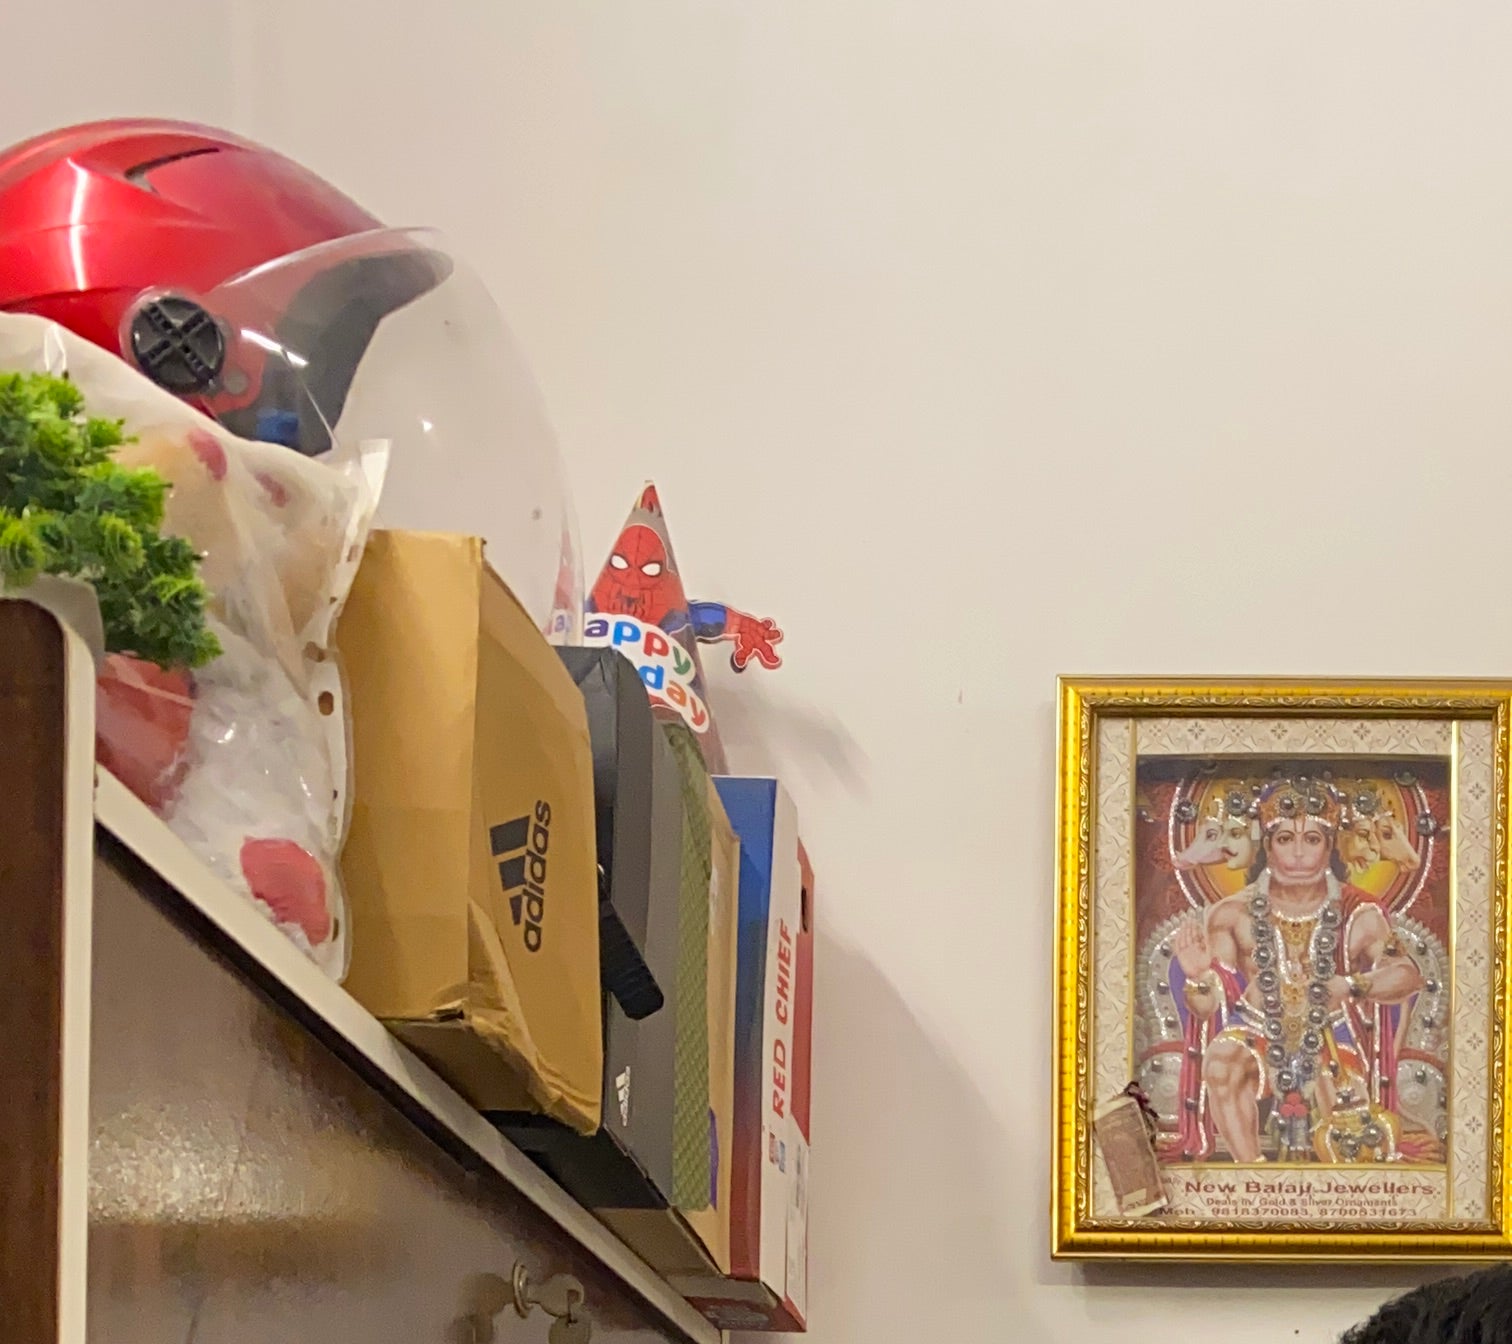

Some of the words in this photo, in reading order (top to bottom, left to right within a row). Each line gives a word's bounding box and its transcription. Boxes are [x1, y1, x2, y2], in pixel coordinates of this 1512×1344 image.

[583, 619, 692, 675] appy
[523, 800, 550, 953] adidas
[775, 918, 792, 1025] CHIEF
[772, 1038, 787, 1119] RED
[1184, 1181, 1237, 1194] New
[1244, 1181, 1312, 1197] Balaji
